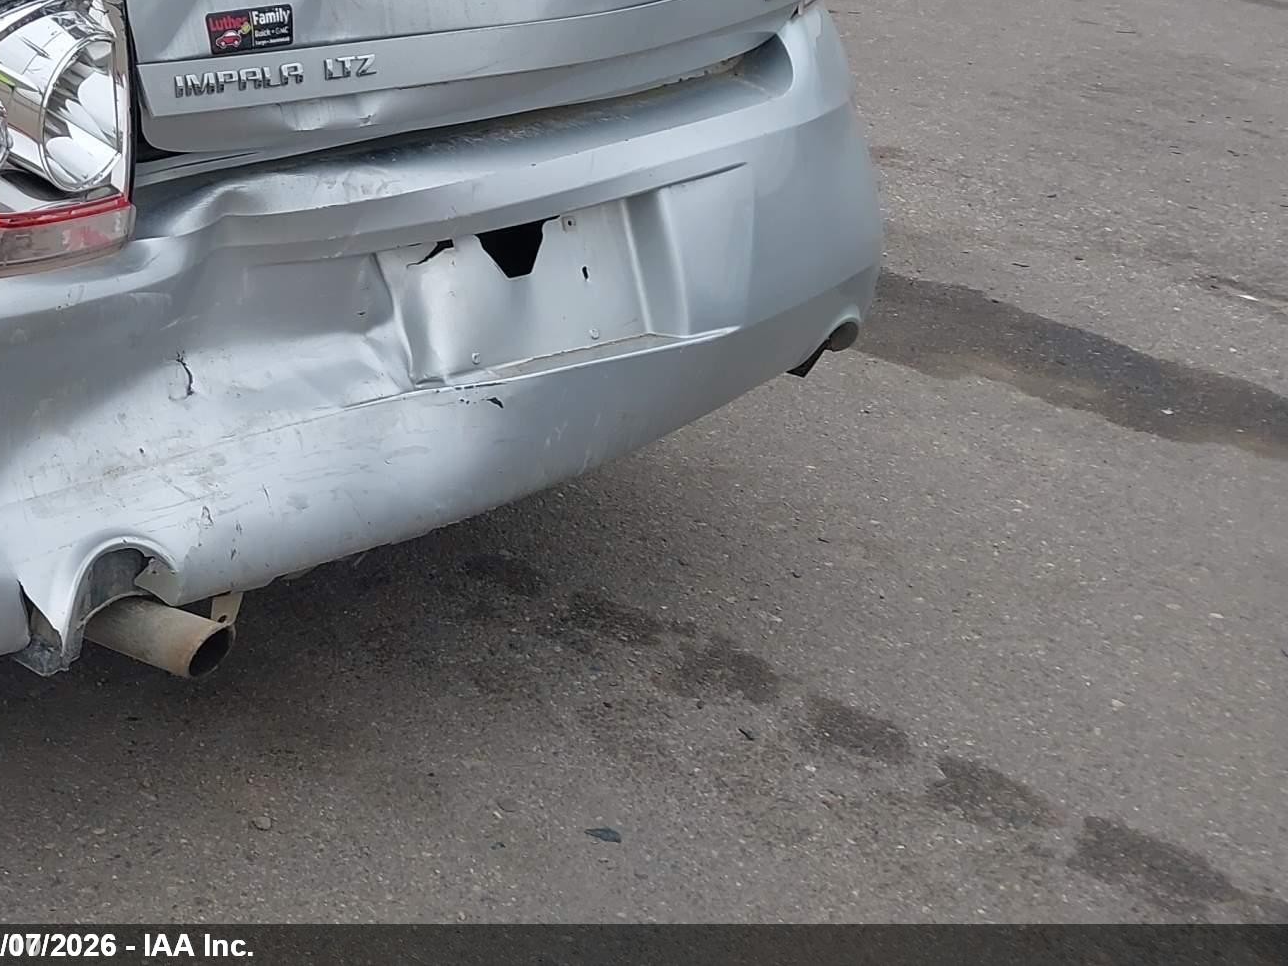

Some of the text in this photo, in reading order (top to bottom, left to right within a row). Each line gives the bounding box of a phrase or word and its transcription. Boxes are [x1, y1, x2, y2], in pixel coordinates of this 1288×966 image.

[252, 7, 290, 26] Family
[174, 54, 377, 98] IMPALA LTZ
